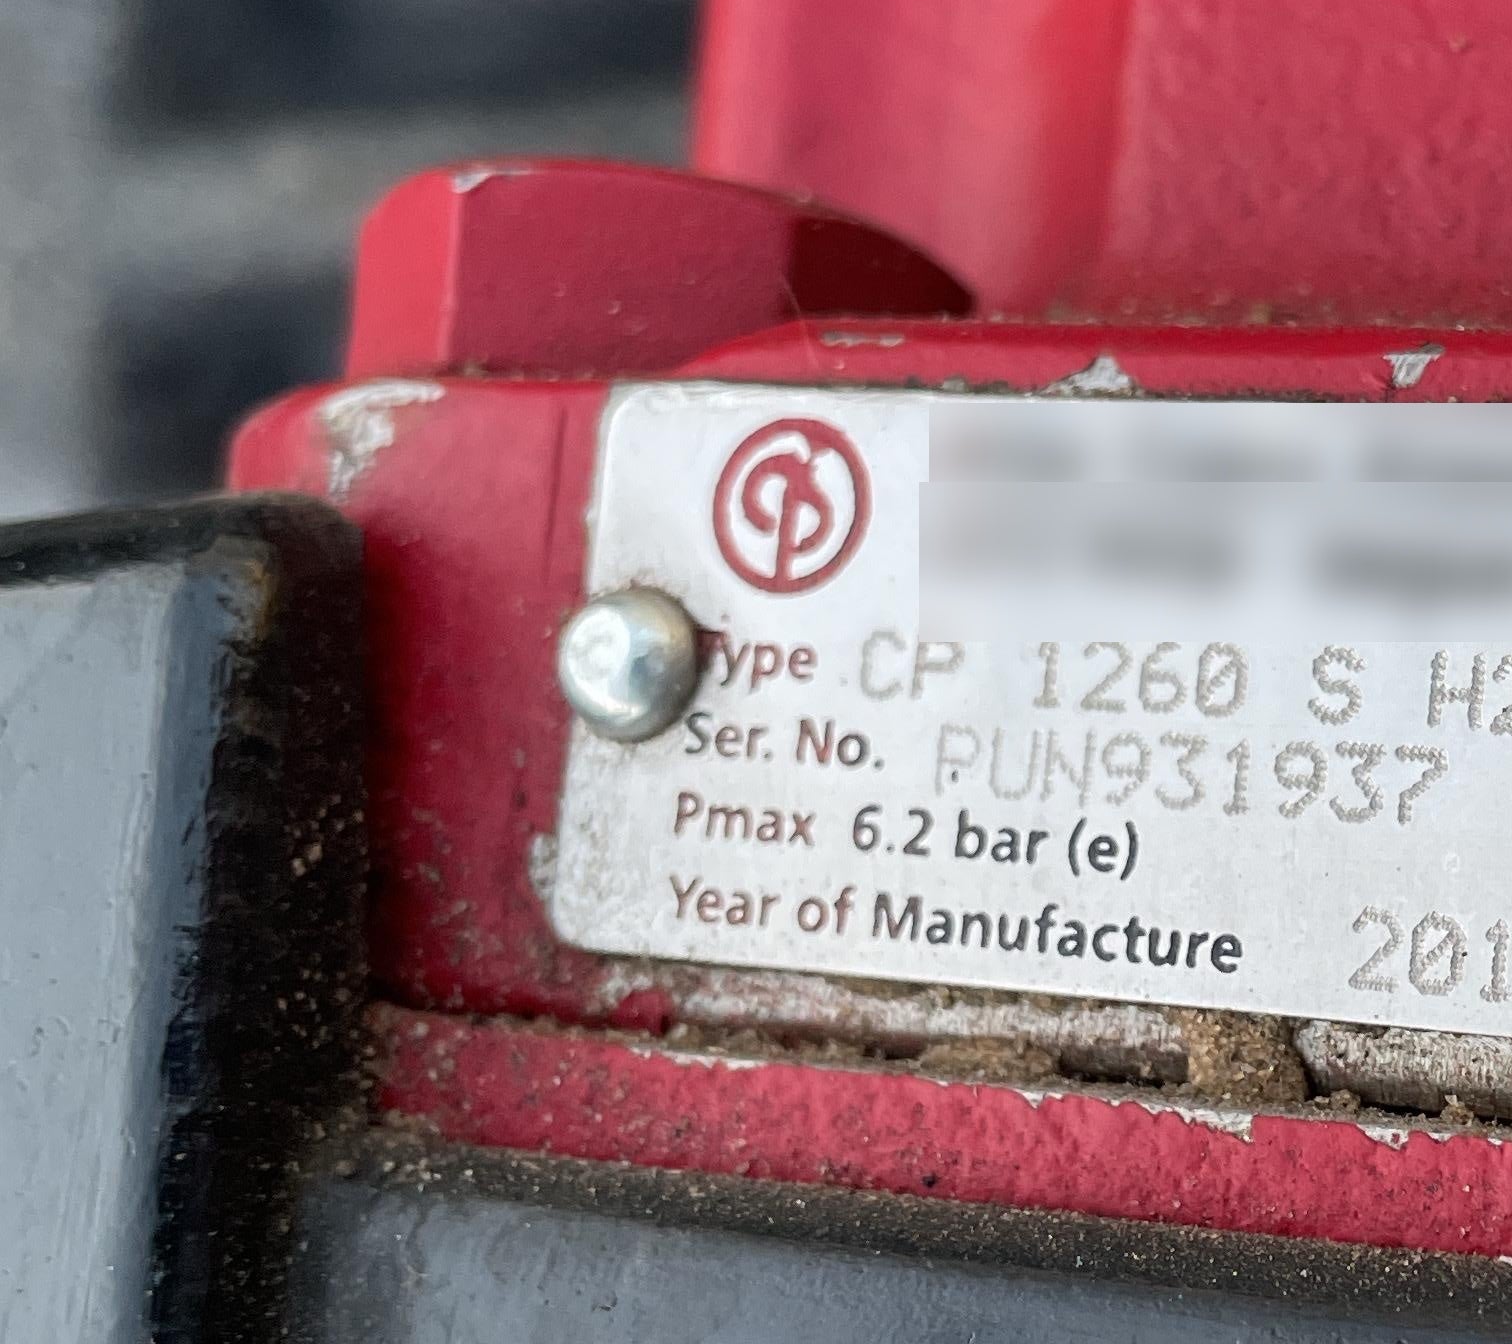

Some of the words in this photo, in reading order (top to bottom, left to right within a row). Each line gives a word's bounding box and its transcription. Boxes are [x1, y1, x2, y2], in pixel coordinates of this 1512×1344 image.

[858, 627, 966, 699] CP
[1031, 641, 1250, 719] 1260
[1307, 643, 1367, 726] S
[684, 711, 772, 760] Ser.
[795, 716, 886, 770] No.
[933, 723, 1450, 825] PUN931937
[672, 790, 816, 847] Pmax
[851, 804, 936, 859] 6.2
[953, 808, 1051, 865] bar
[1066, 816, 1141, 881] (e)
[668, 876, 783, 928] Year
[796, 885, 858, 936] of
[871, 891, 1244, 974] Manufacture
